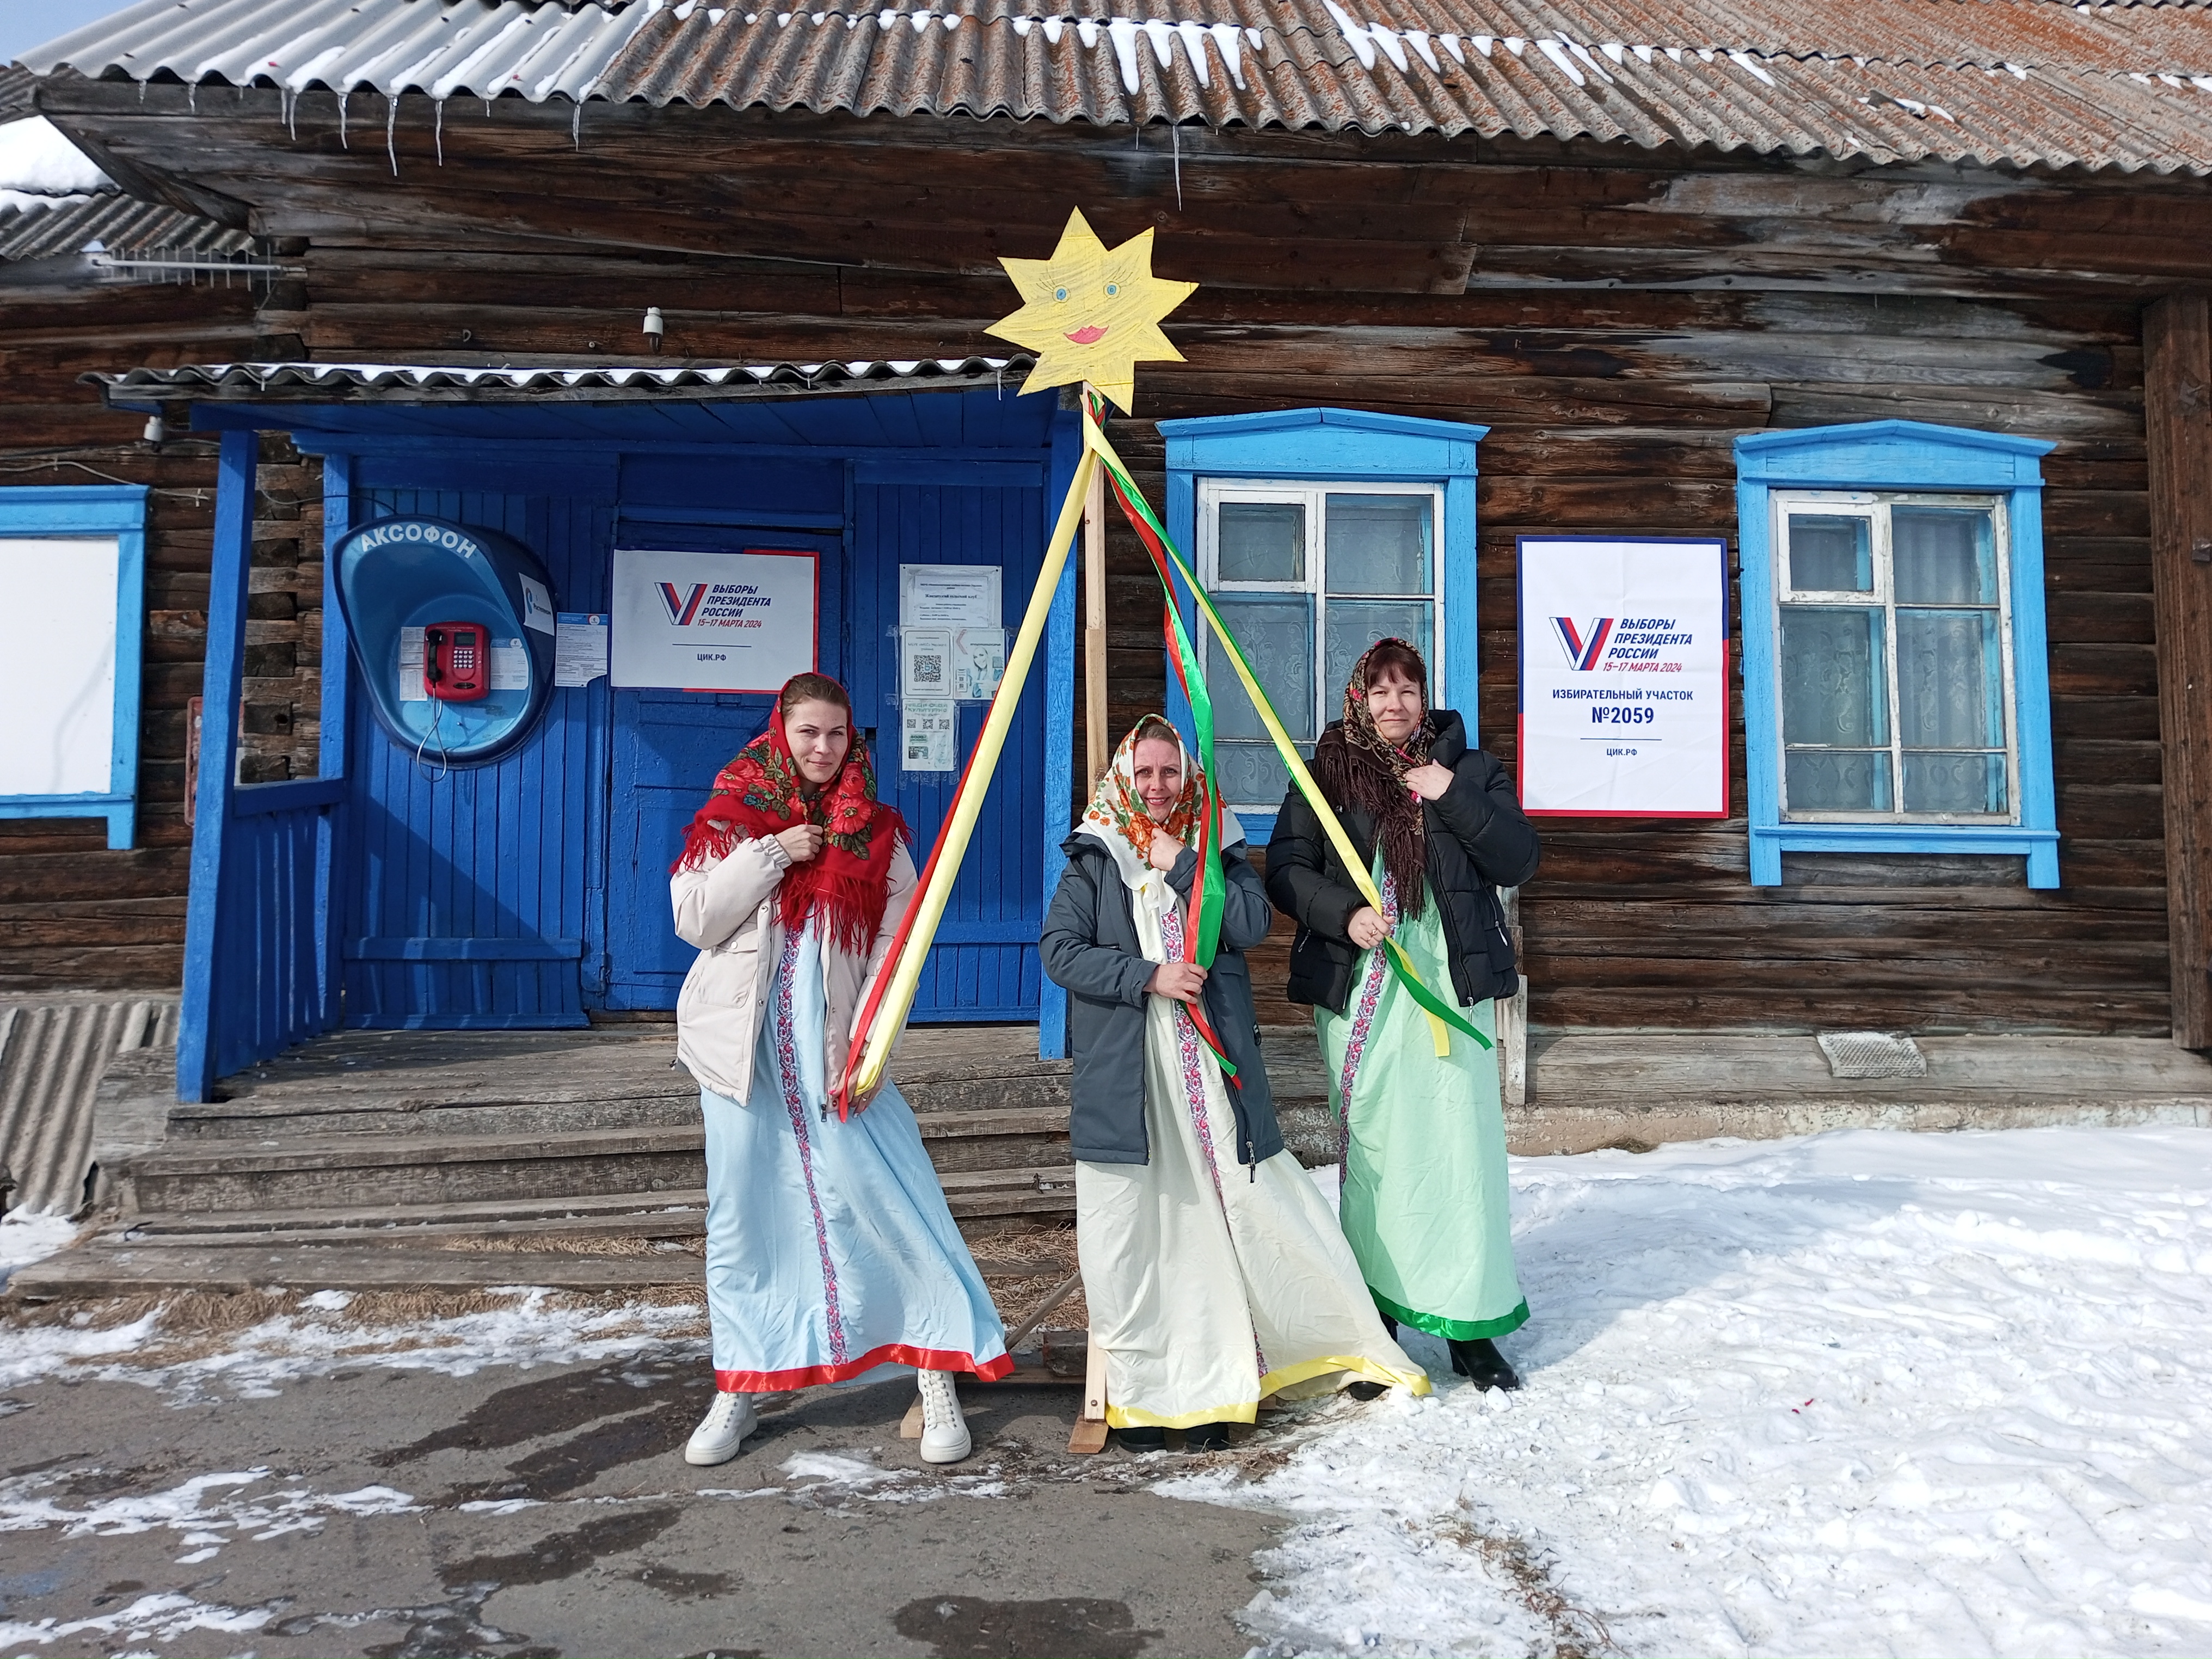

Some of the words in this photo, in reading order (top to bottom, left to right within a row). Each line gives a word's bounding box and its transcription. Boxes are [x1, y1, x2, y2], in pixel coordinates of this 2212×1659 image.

[361, 524, 477, 558] АКСОФОН
[712, 584, 758, 594] ВЫБОРЫ
[706, 596, 771, 607] ПРЕЗИДЕНТА
[701, 607, 744, 617] РОССИИ
[718, 619, 742, 628] МАРТА
[744, 620, 762, 628] 2024
[1620, 618, 1676, 630] ВЫБОРЫ
[1614, 633, 1693, 646] ПРЕЗИДЕНТА
[697, 654, 727, 662] ЦИК.РФ
[1608, 648, 1660, 659] РОССИИ
[1627, 662, 1660, 672] МАРТА
[1660, 662, 1682, 672] 2024
[1552, 688, 1643, 700] ИЗБИРАТЕЛЬНЫЙ
[1646, 690, 1694, 701] УЧАСТОК
[1592, 706, 1654, 724] №2059
[1606, 748, 1638, 757] ЦИК.РФ
